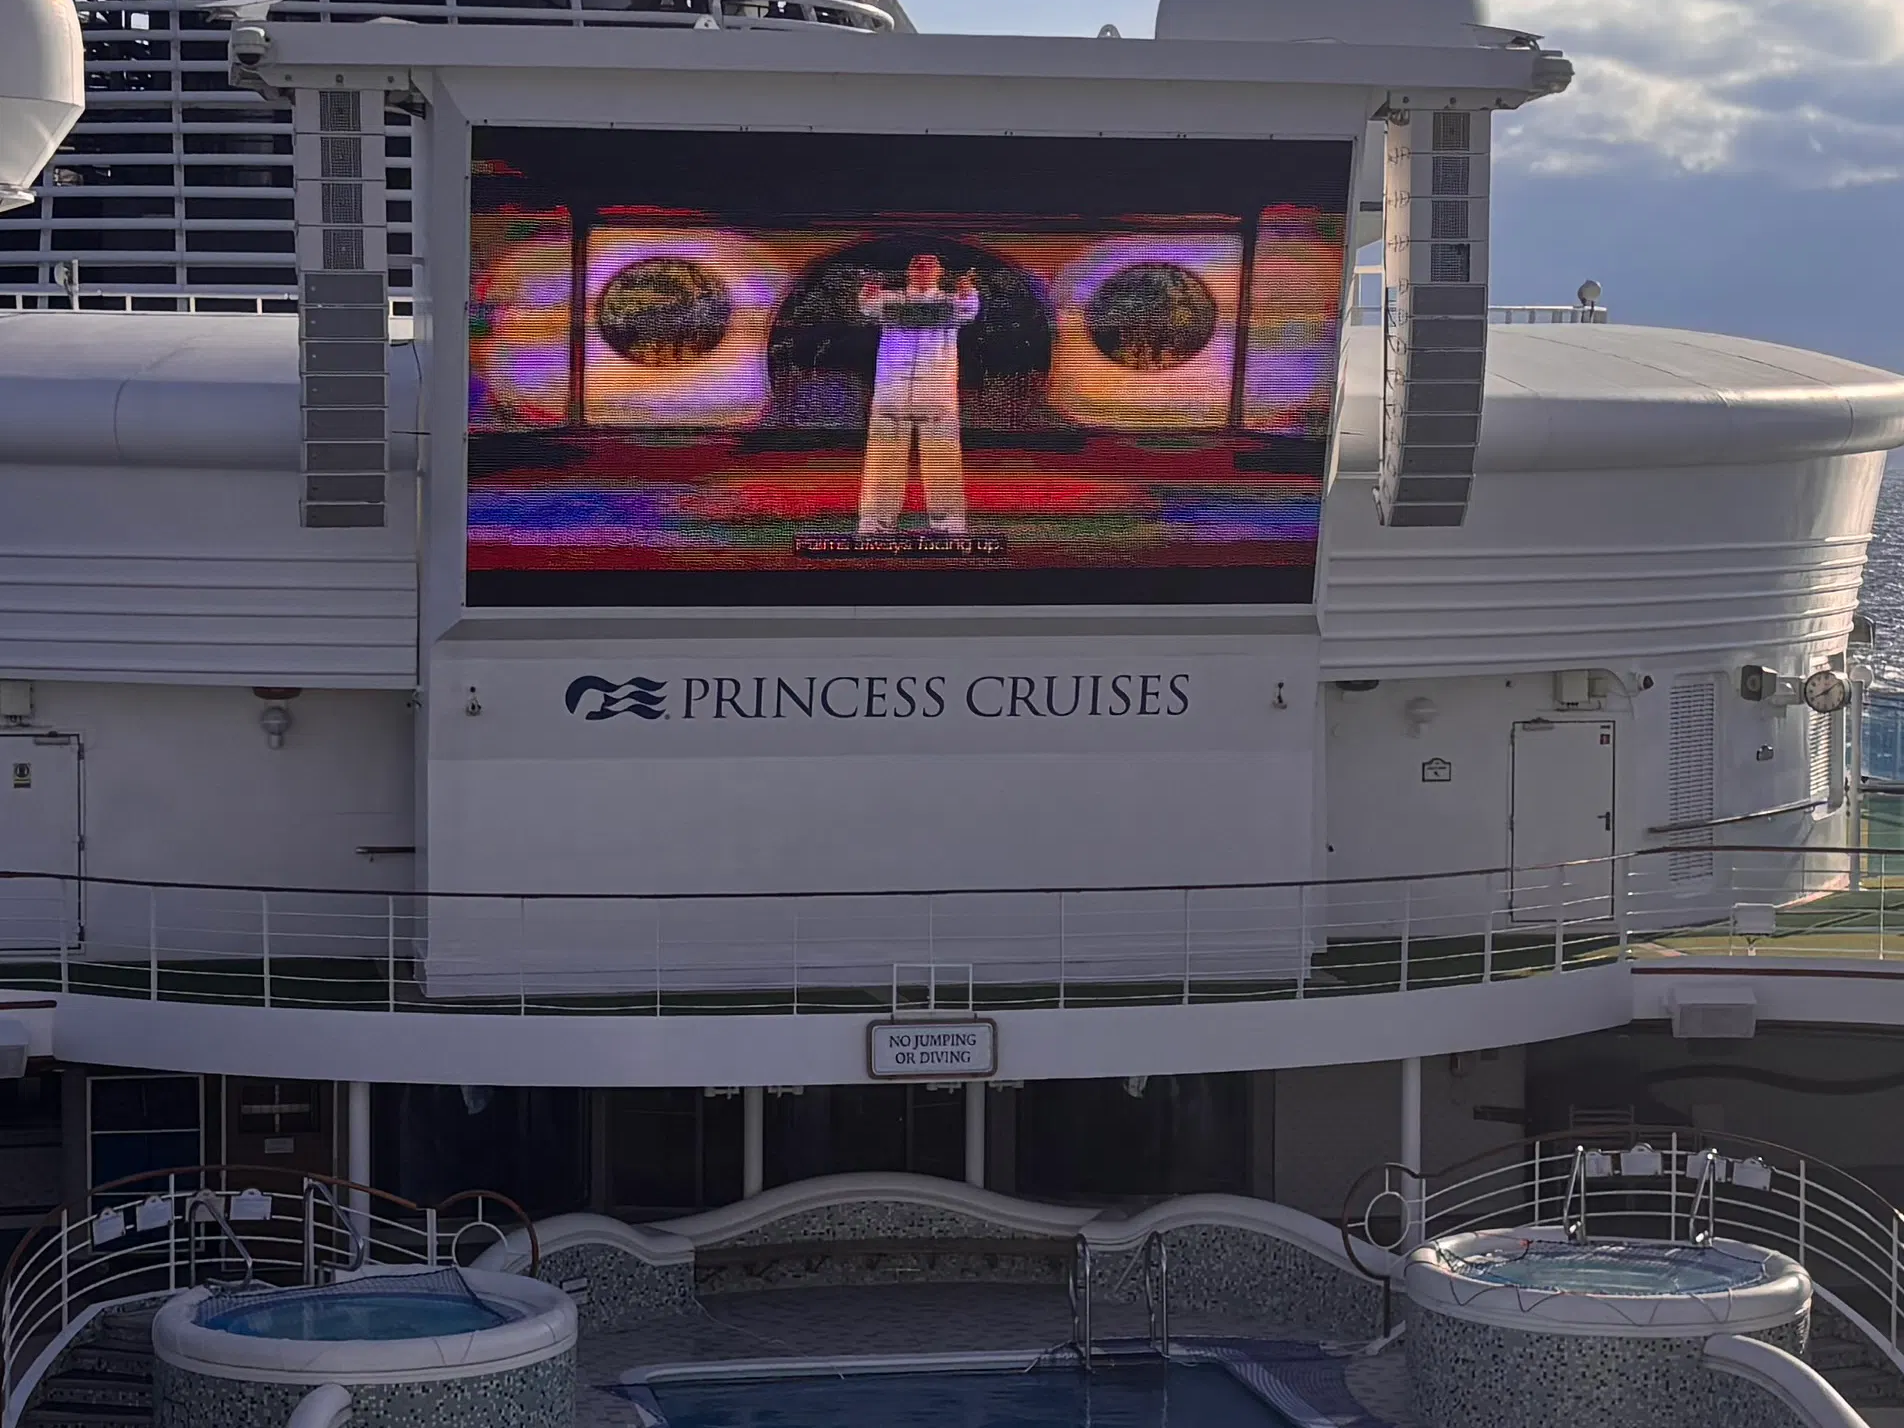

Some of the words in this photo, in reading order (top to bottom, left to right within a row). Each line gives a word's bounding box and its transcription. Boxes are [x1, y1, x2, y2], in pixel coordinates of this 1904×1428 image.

[681, 676, 946, 719] PRINCESS
[965, 674, 1190, 717] CRUISES
[889, 1035, 911, 1048] NO
[912, 1033, 976, 1050] JUMPING
[895, 1052, 916, 1064] OR
[919, 1051, 971, 1064] DIVING
